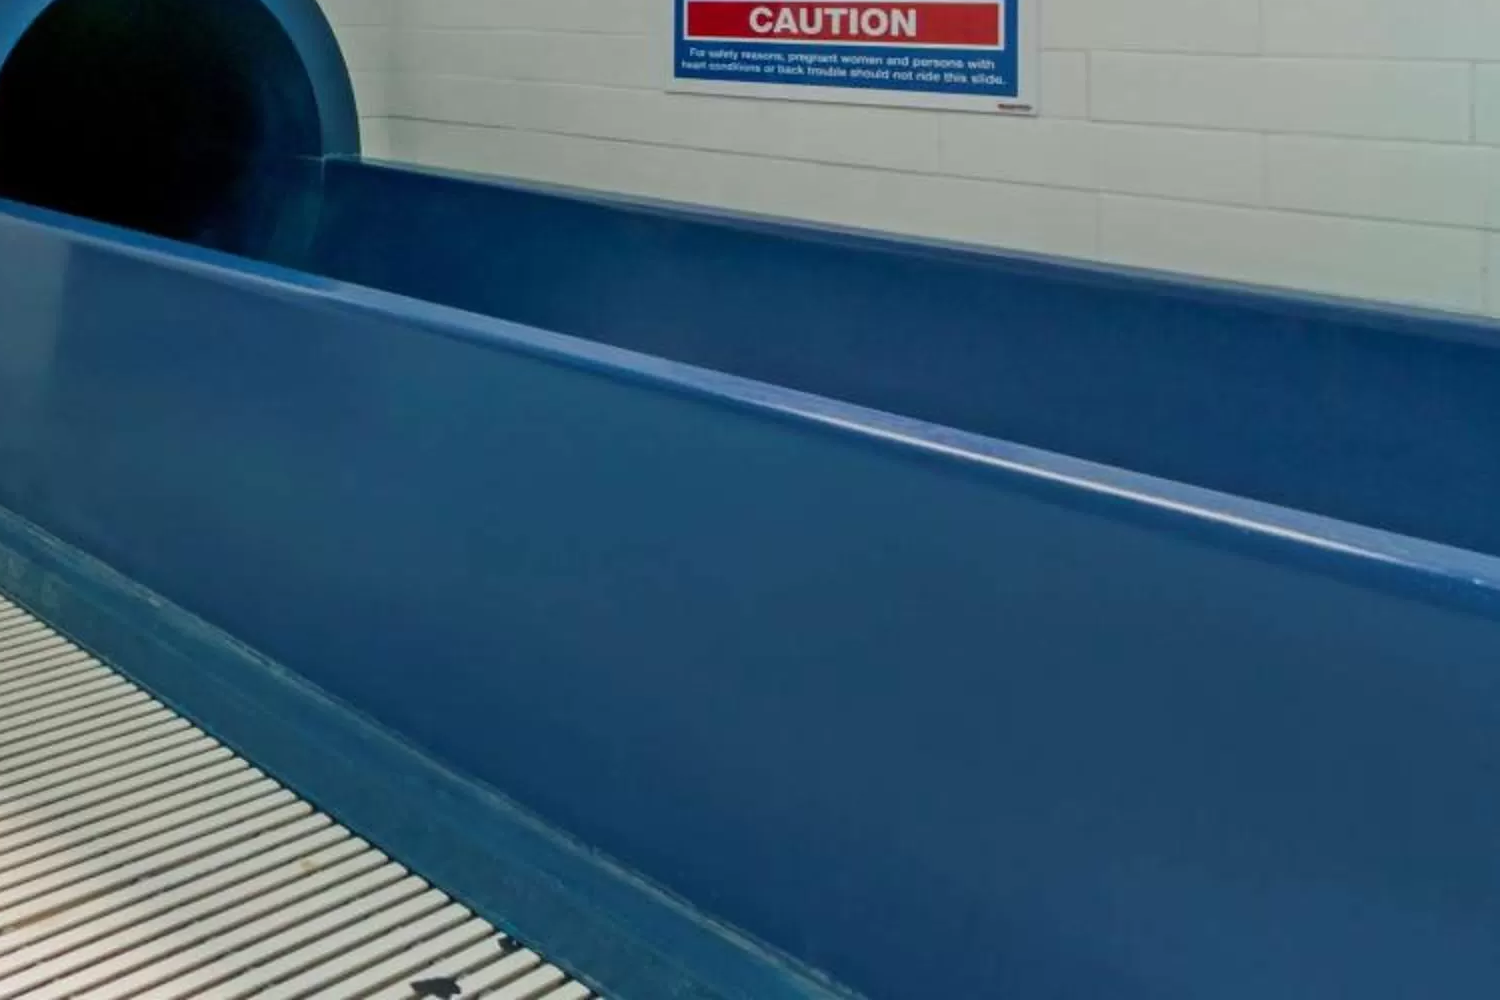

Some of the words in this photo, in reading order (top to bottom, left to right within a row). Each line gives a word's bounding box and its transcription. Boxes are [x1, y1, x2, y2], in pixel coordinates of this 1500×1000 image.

[749, 6, 916, 36] CAUTION
[690, 48, 704, 57] For
[788, 54, 837, 63] pregnant
[840, 56, 882, 64] women
[886, 56, 908, 66] and
[912, 59, 964, 68] persons
[967, 59, 994, 69] with
[778, 64, 803, 74] back
[807, 66, 846, 76] trouble
[850, 68, 889, 78] should
[892, 70, 912, 80] not
[915, 71, 939, 81] ride
[944, 72, 966, 82] this
